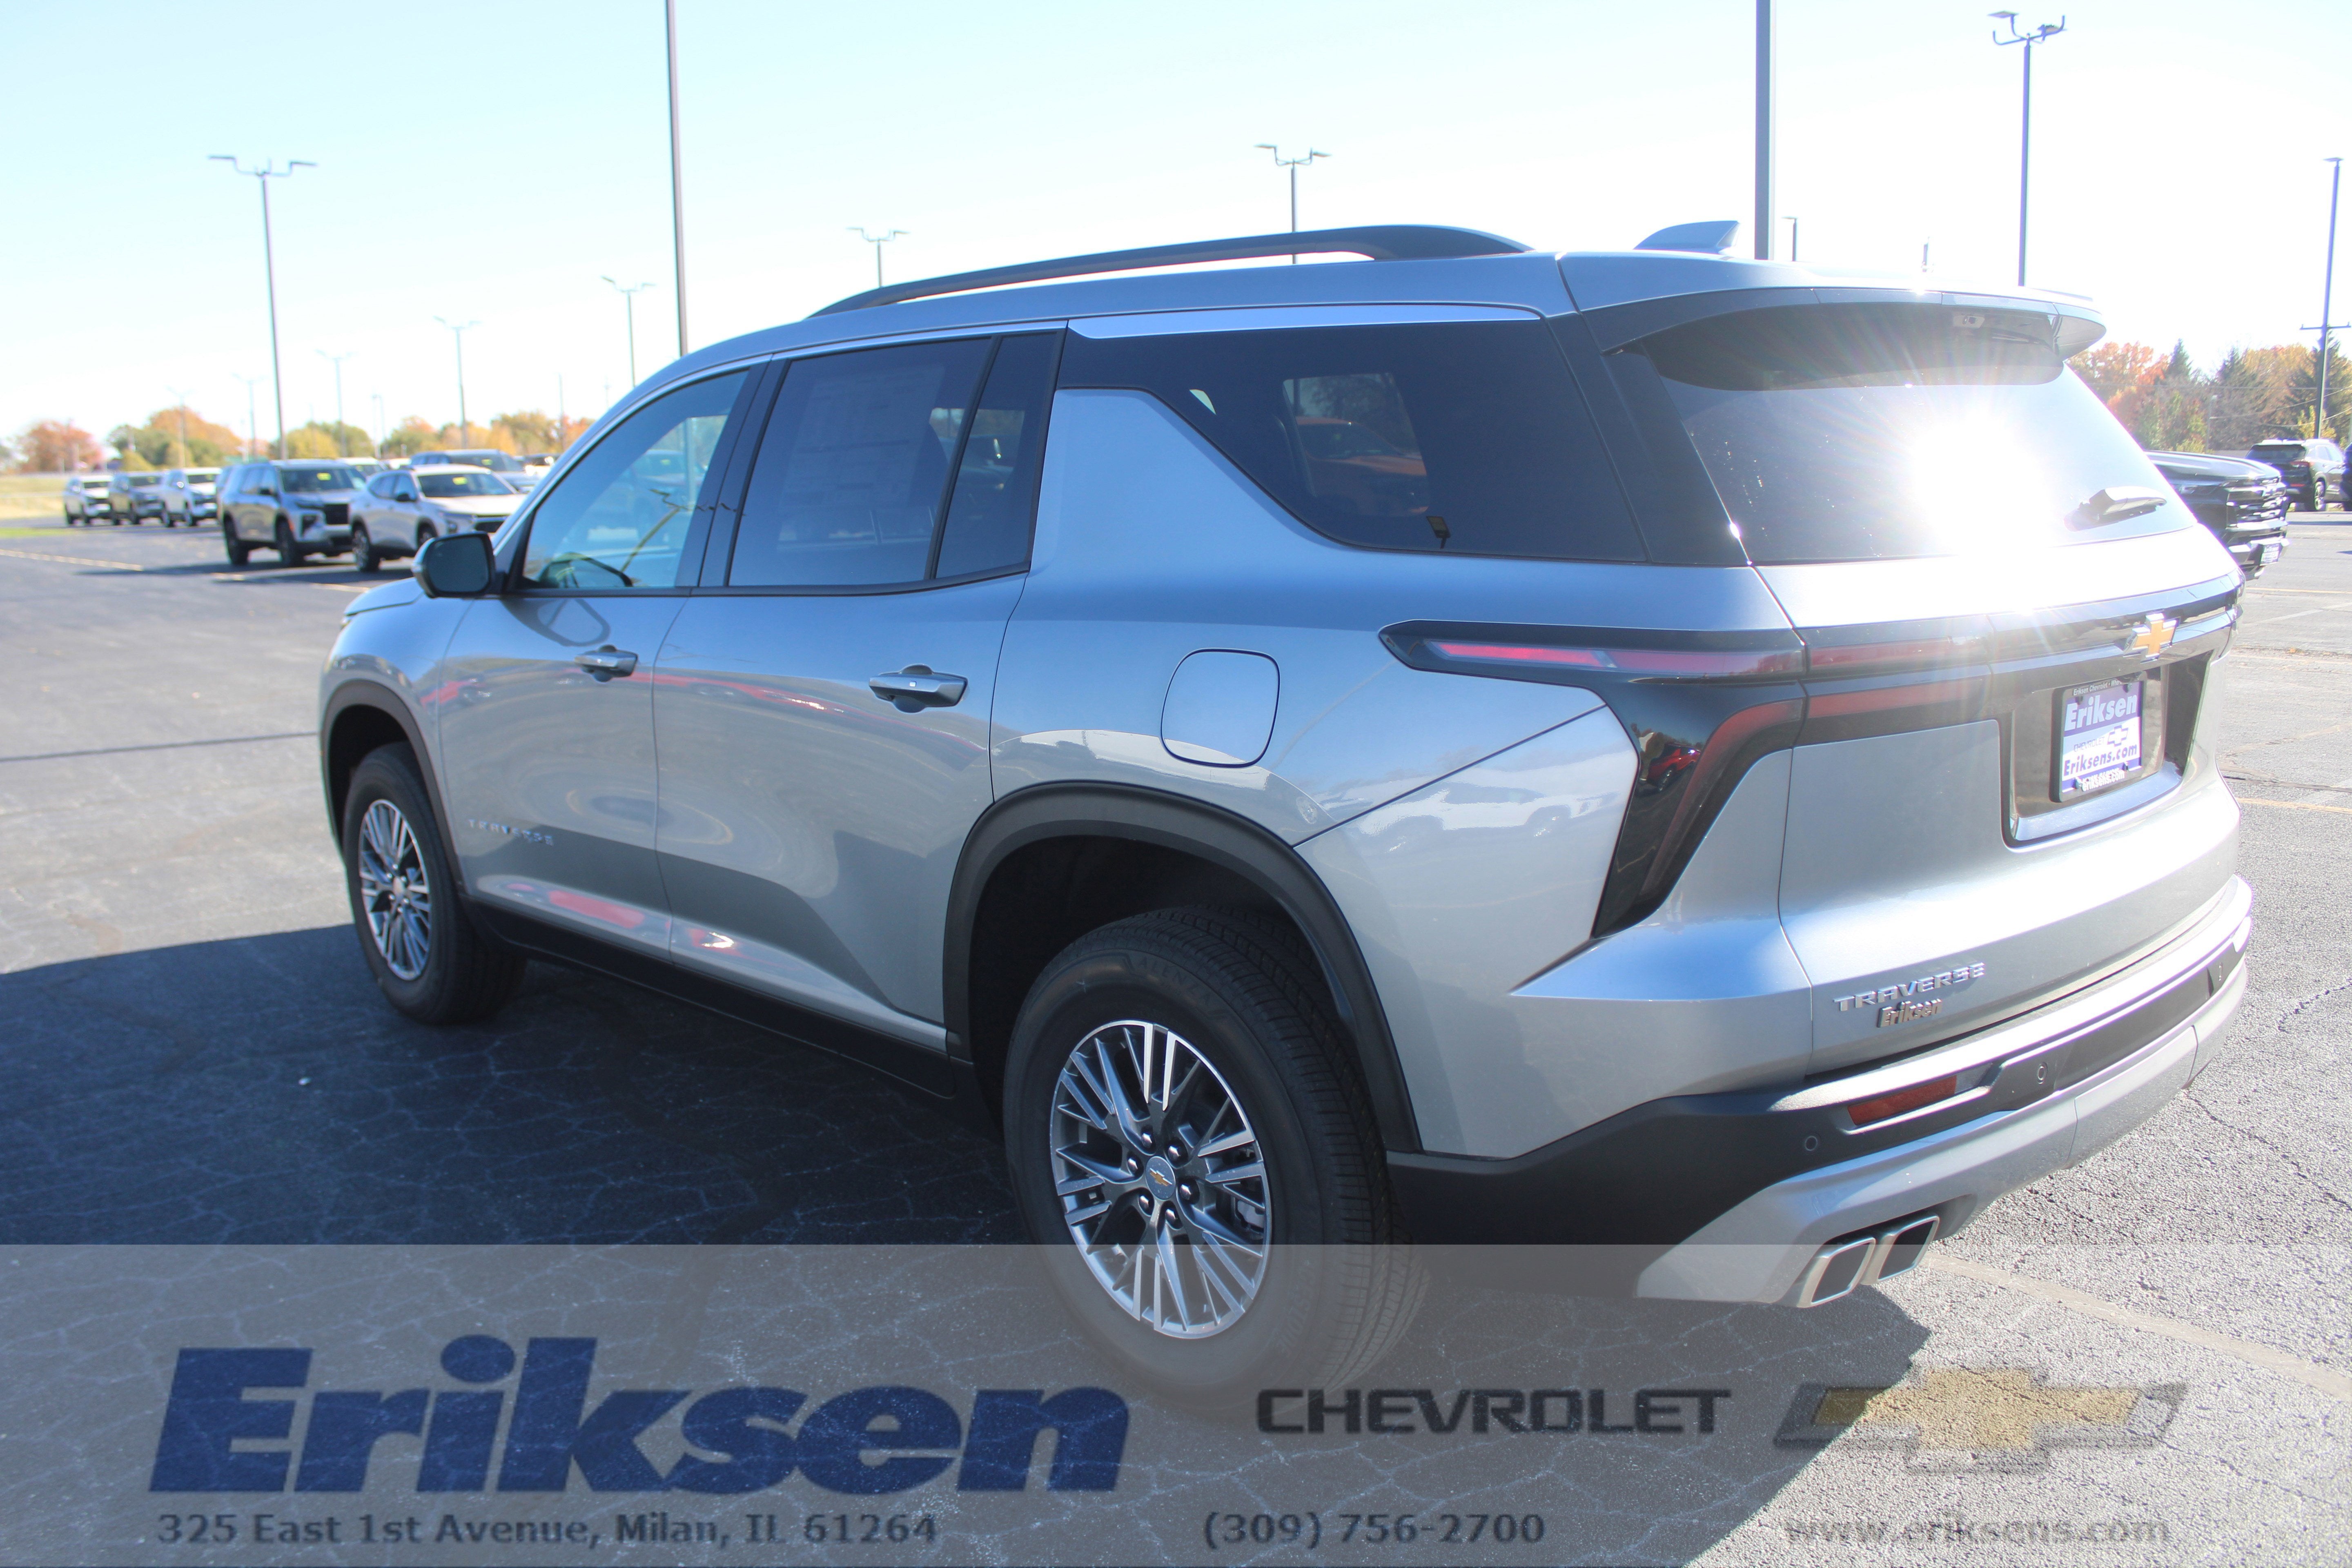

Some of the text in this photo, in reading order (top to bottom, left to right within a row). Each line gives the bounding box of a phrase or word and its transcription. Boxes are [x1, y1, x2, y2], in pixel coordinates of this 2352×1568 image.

[2064, 694, 2138, 732] Eriksen
[2063, 744, 2137, 777] Eriksens.com
[2073, 736, 2105, 752] CHEVROLET
[1137, 956, 1211, 1006] ALENZA
[1833, 962, 1986, 1012] TRAVERSE
[1877, 997, 1943, 1028] Eriksen
